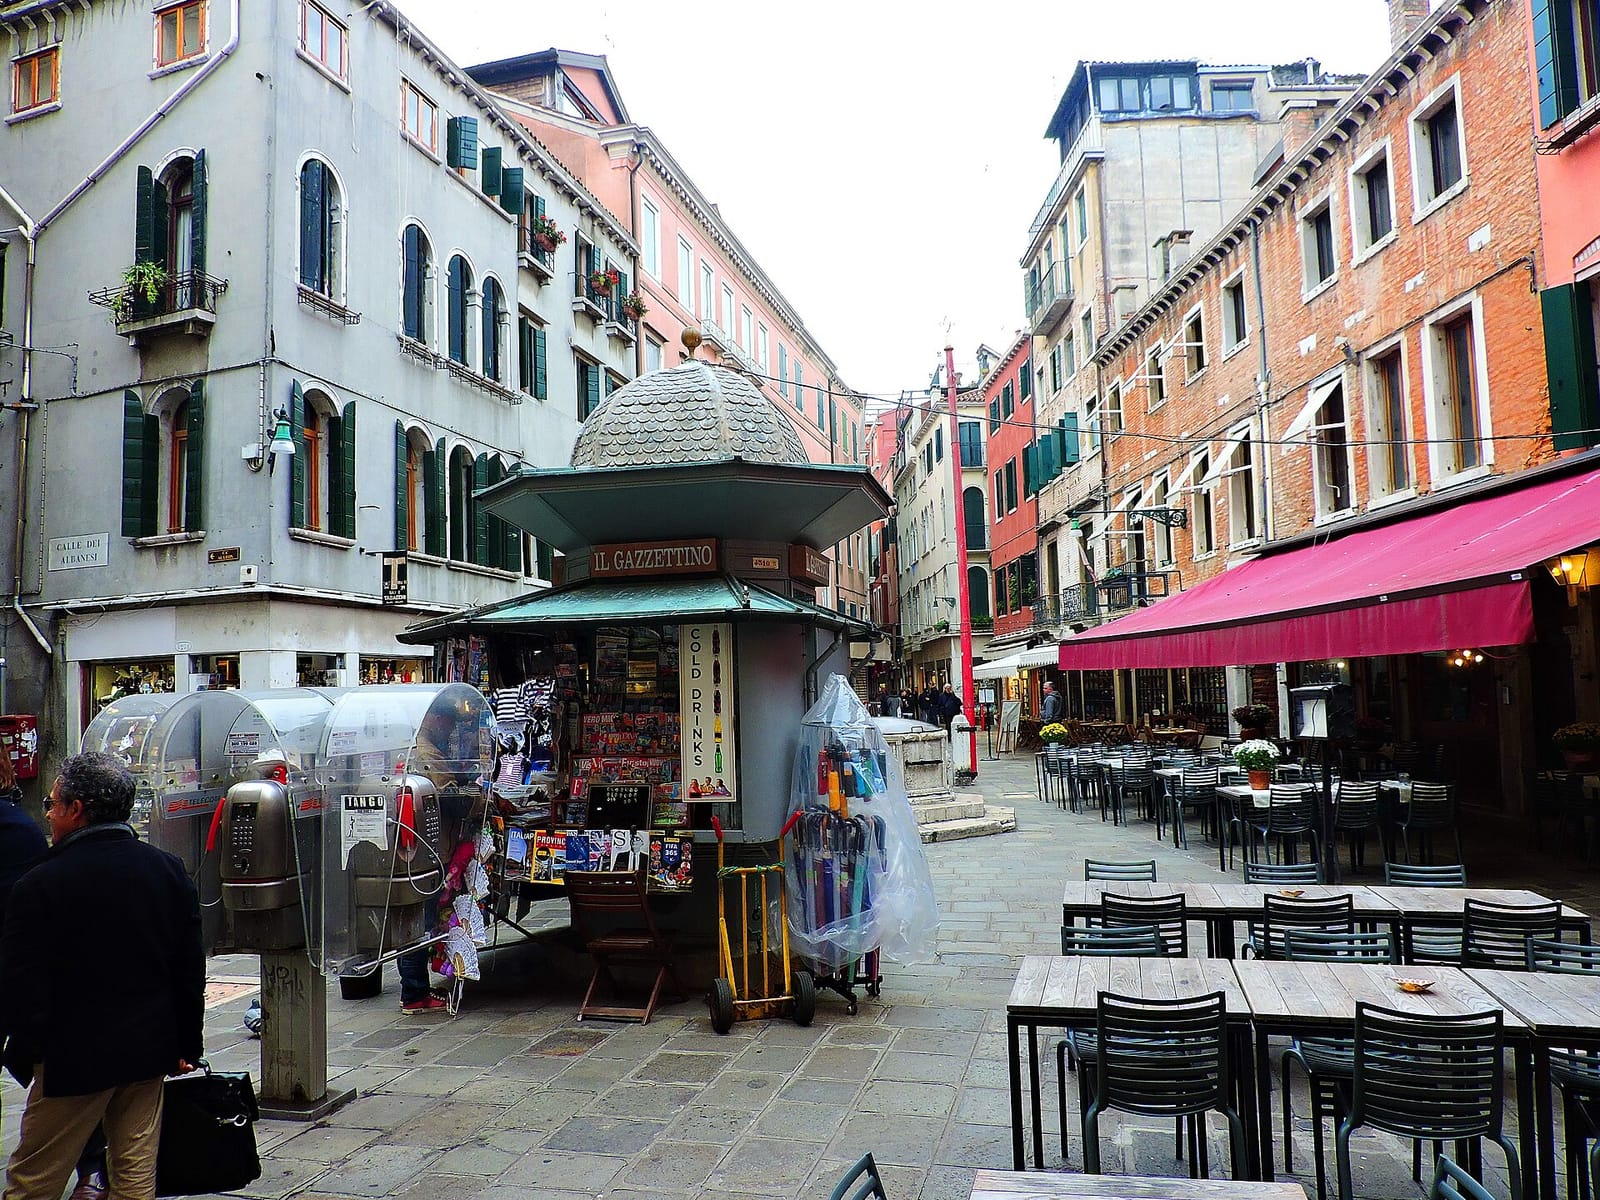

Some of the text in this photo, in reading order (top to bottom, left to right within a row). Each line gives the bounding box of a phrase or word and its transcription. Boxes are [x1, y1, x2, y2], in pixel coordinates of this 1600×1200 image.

[56, 539, 100, 551] CALLE DEI
[61, 553, 98, 564] ALBANESI
[594, 545, 713, 571] IL GAZZETTINO
[384, 557, 406, 590] T
[690, 628, 703, 767] COLD DRINKS
[348, 796, 384, 808] TANGO
[536, 835, 566, 846] PROVINC
[613, 830, 626, 847] S
